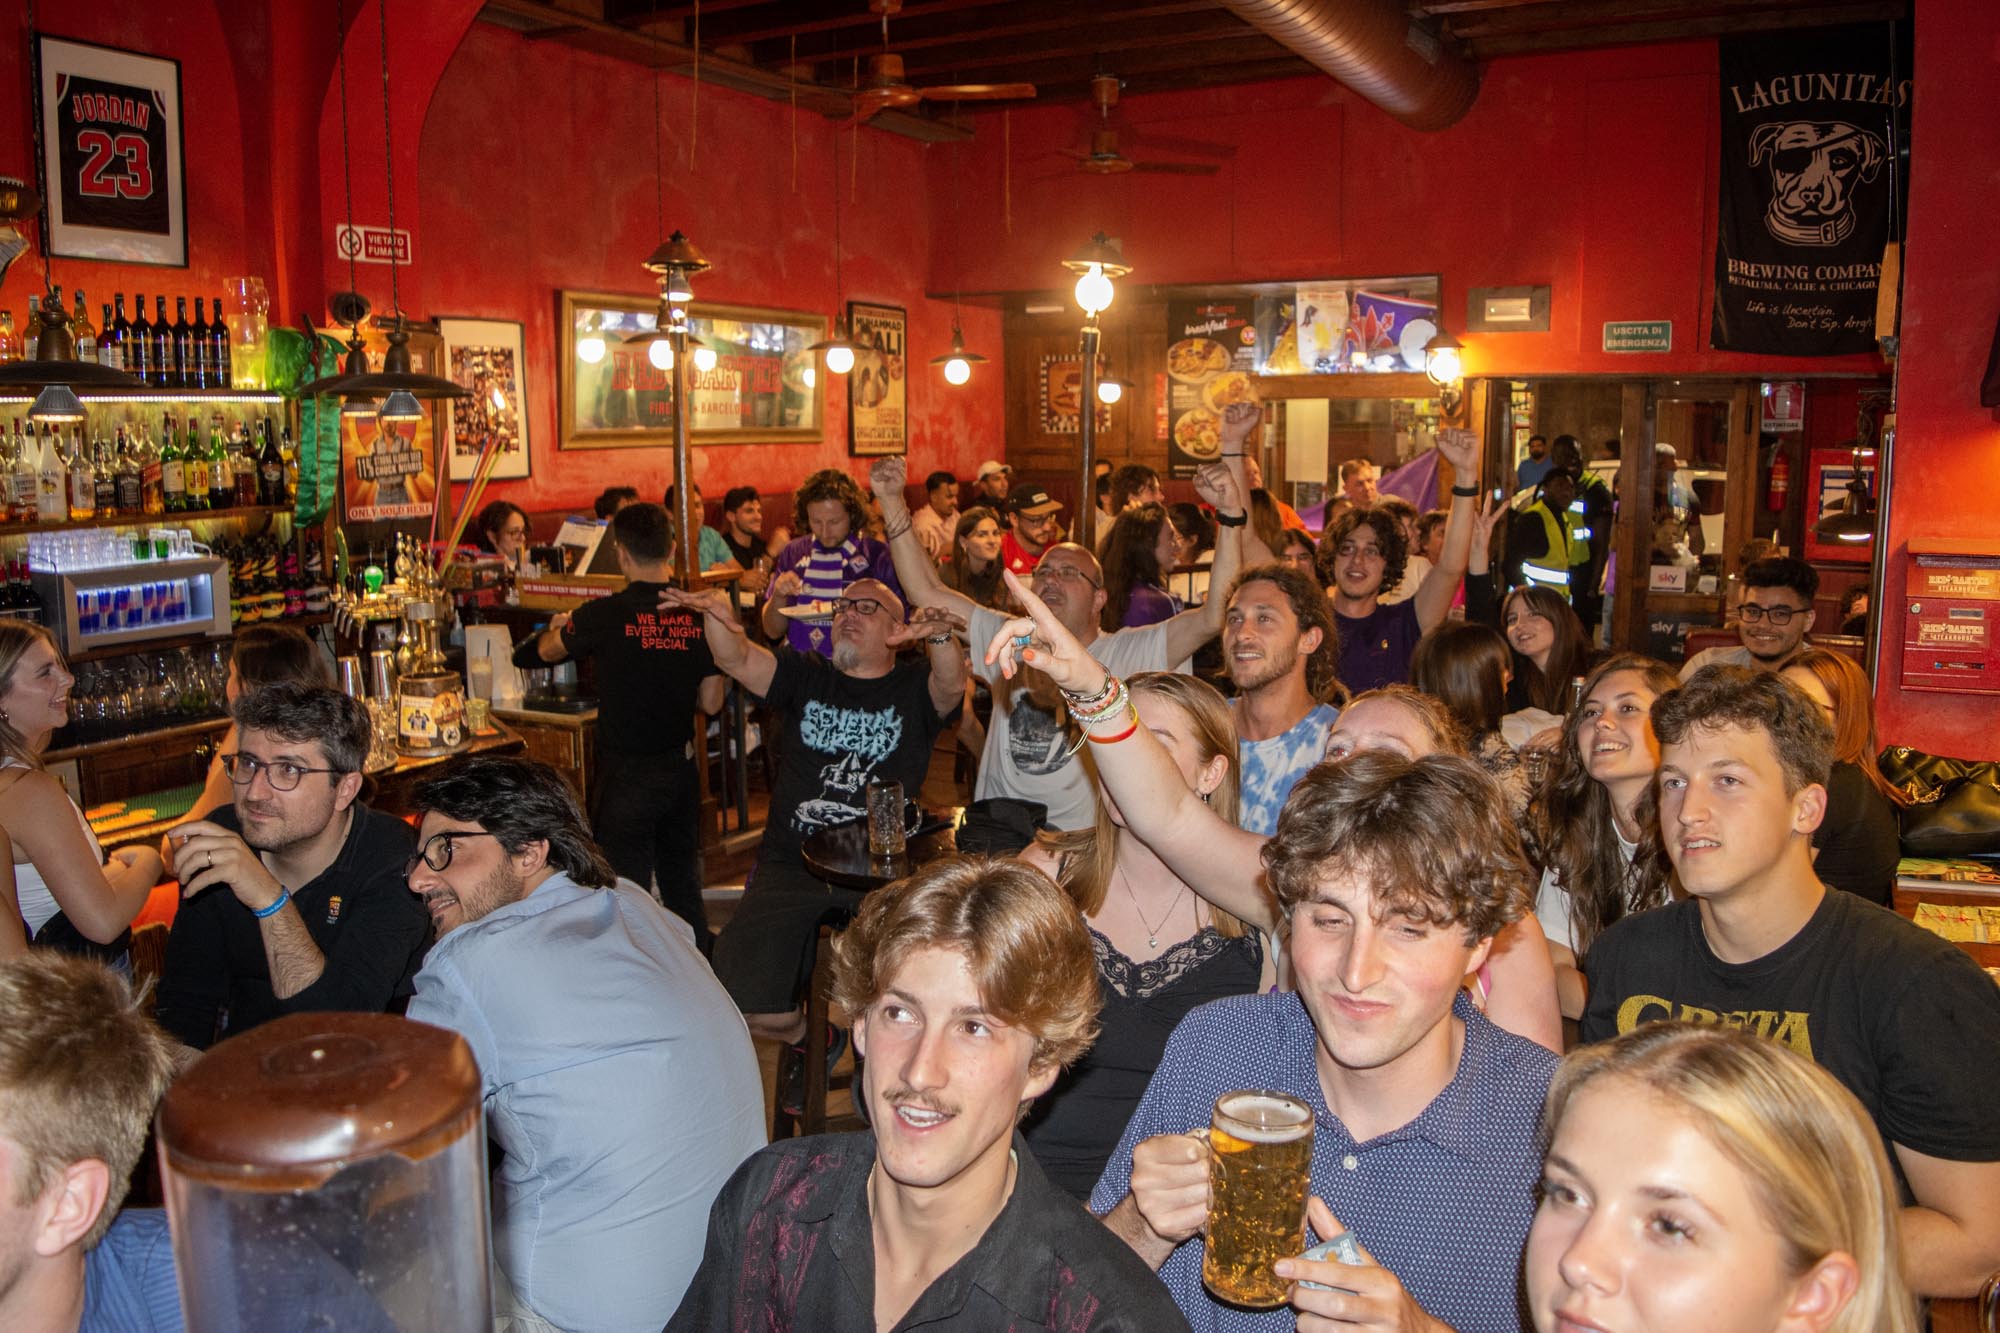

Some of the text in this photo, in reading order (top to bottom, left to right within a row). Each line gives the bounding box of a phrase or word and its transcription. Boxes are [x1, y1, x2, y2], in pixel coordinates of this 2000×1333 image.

[1731, 73, 1913, 113] LAGUNITAS
[73, 93, 149, 131] JORDAN
[78, 129, 153, 199] 23
[1728, 258, 1882, 280] BREWING COMPAN
[1747, 300, 1766, 314] Life
[1768, 303, 1778, 314] is
[1613, 326, 1662, 335] USCITA DI
[1787, 314, 1816, 329] Don't
[1820, 317, 1840, 332] Sip.
[873, 331, 902, 356] ALI
[1606, 338, 1668, 347] EMERGENZA
[351, 507, 376, 519] ONLY
[1658, 571, 1679, 584] sky
[637, 613, 693, 626] WE MAKE
[625, 624, 703, 639] EVERY NIGHT
[1651, 620, 1674, 635] sky
[641, 638, 688, 650] SPECIAL
